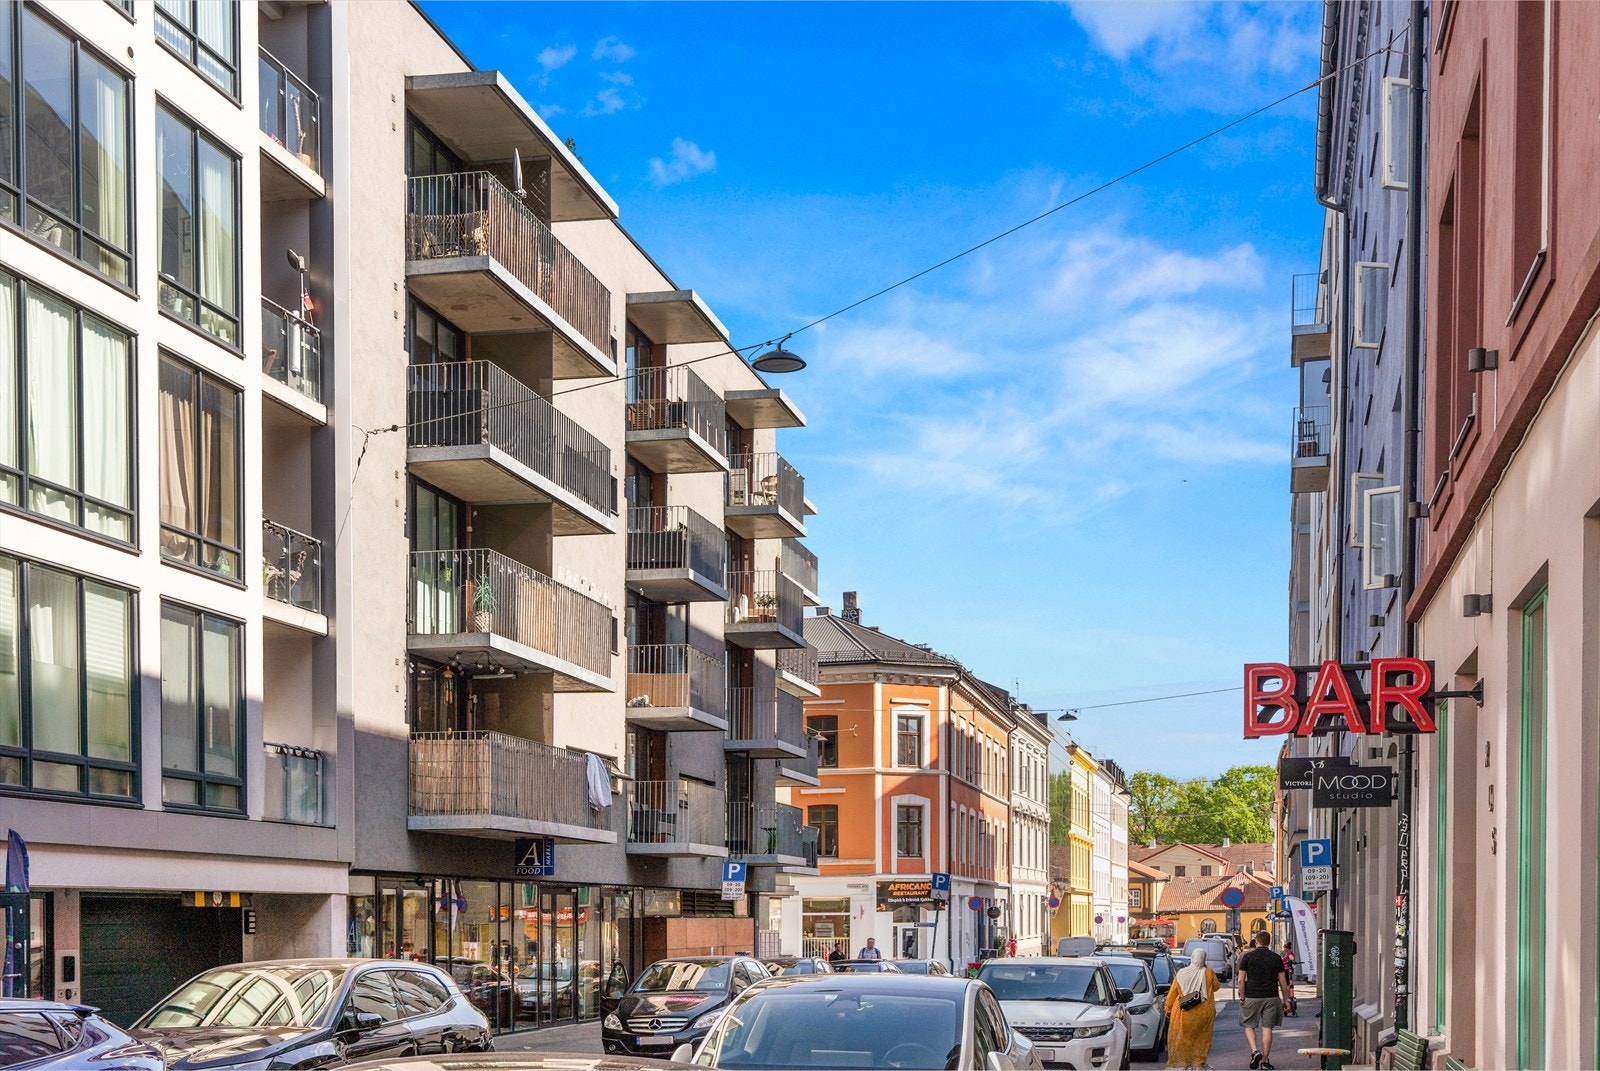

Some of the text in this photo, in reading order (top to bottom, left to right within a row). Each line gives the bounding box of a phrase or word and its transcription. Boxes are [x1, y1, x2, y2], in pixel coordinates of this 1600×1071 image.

[1244, 657, 1438, 737] BAR
[1318, 775, 1387, 790] MOOD
[1330, 792, 1373, 800] studio
[518, 842, 541, 866] A
[1308, 842, 1324, 864] P
[516, 867, 541, 875] FOOD
[728, 863, 741, 879] P
[935, 875, 946, 888] P
[1273, 888, 1280, 898] P
